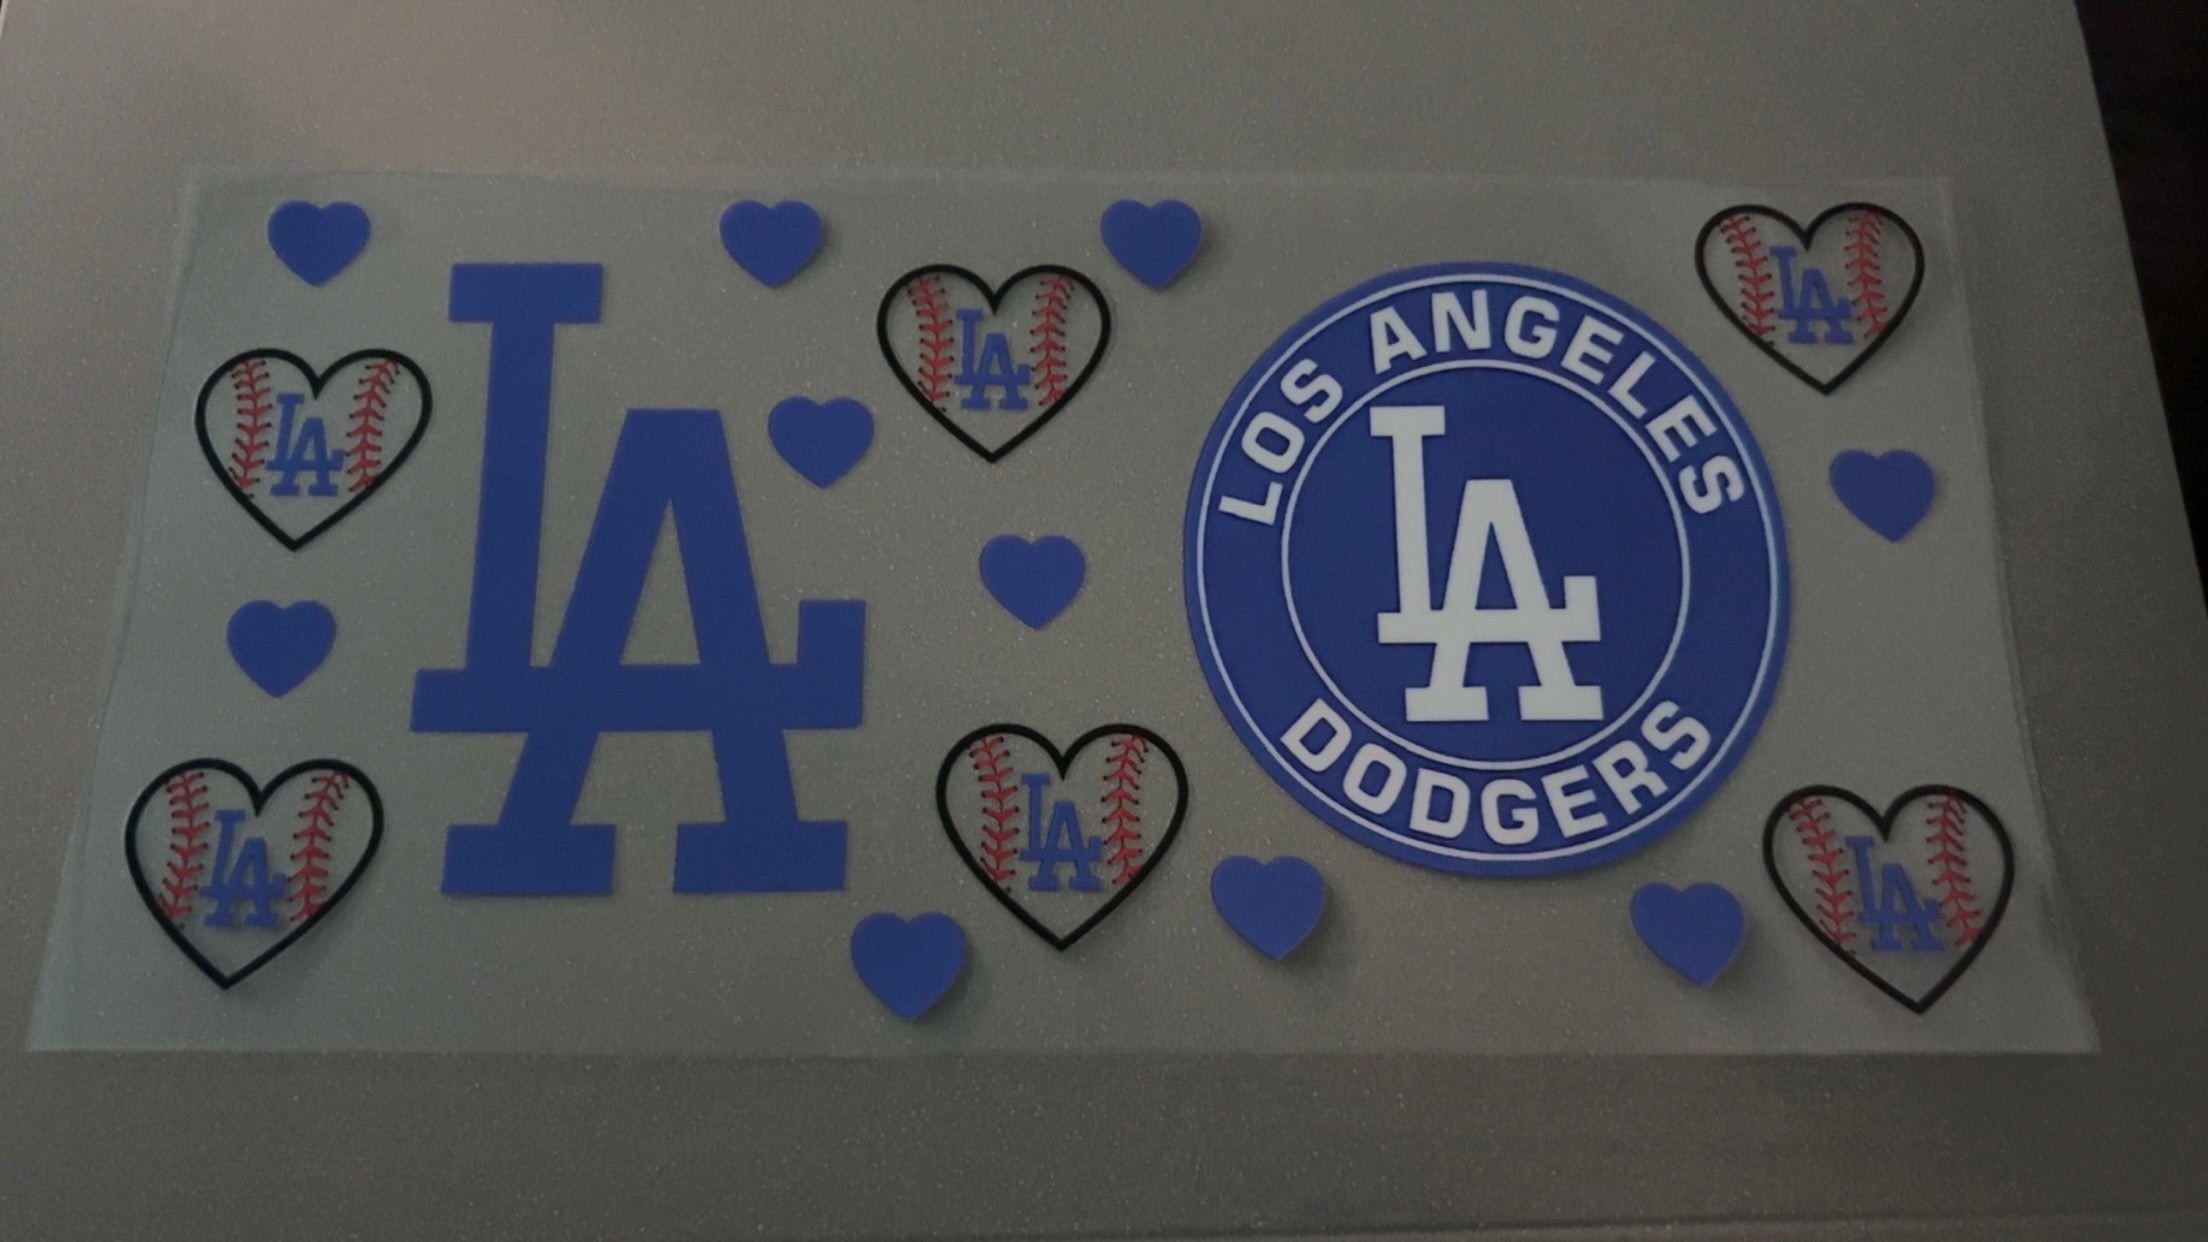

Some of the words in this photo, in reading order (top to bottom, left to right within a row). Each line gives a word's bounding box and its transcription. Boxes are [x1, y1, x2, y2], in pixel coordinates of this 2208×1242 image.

[1218, 358, 1343, 526] LOS
[1369, 289, 1747, 518] ANGELES
[411, 263, 865, 896] LA
[1370, 405, 1603, 722] LA
[1281, 699, 1713, 846] DODGERS
